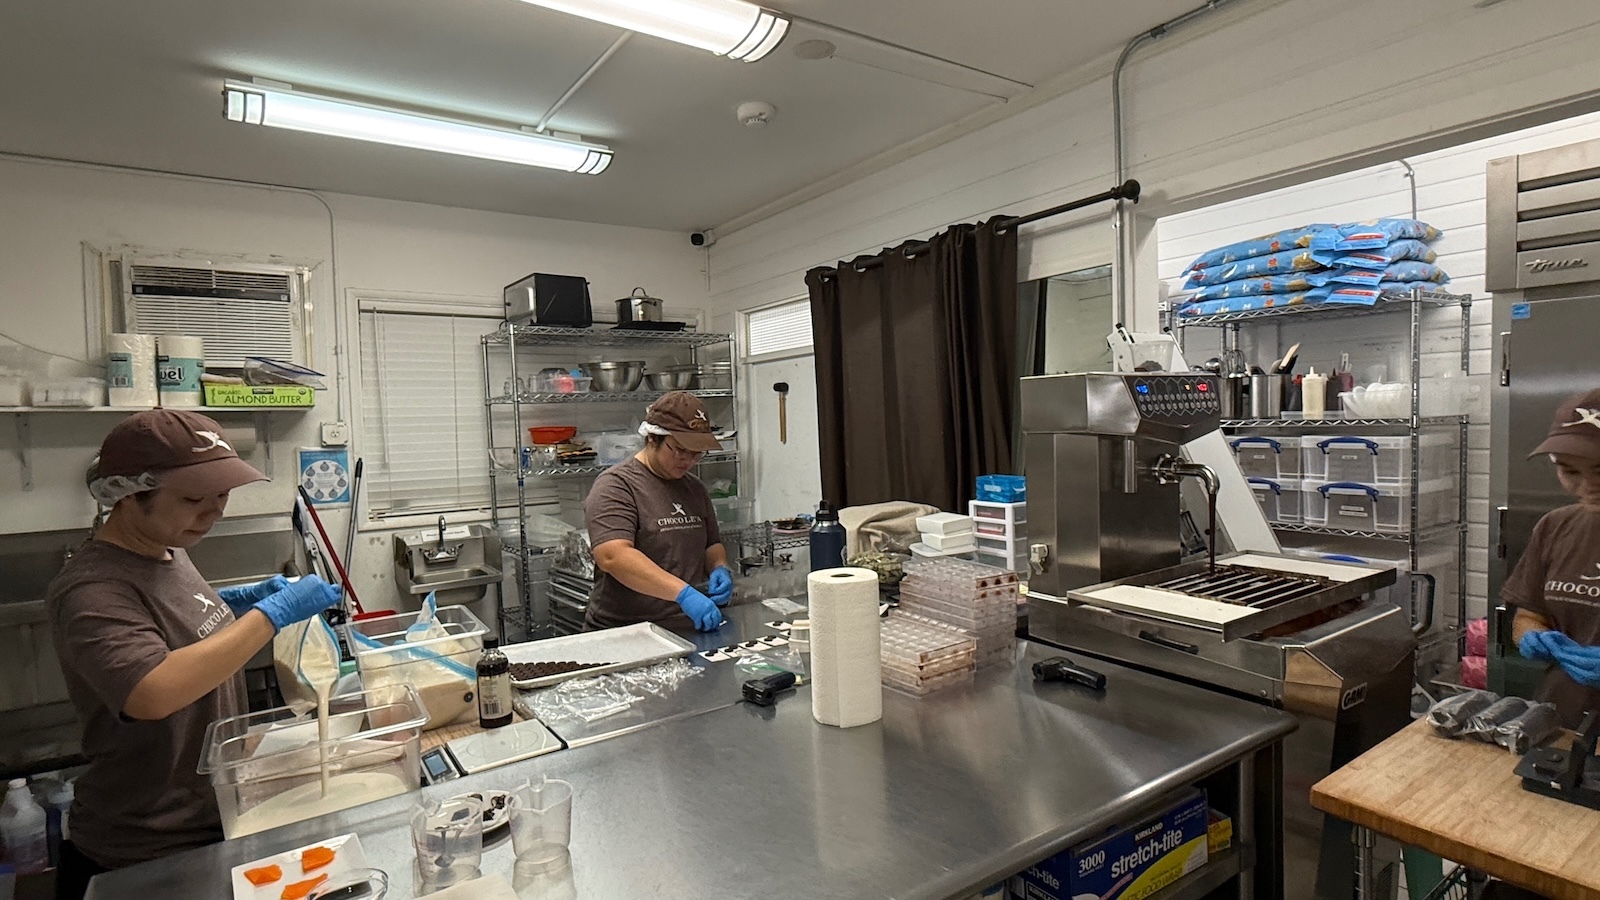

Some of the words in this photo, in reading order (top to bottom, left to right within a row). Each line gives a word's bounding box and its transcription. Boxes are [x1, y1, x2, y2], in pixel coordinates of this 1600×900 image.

[224, 395, 267, 404] ALMOND
[269, 395, 302, 404] BUTTER
[658, 516, 684, 526] CHOCO
[197, 612, 221, 639] CHOCO
[1134, 822, 1164, 841] KIRKLAND
[1078, 850, 1106, 873] 3000
[1111, 829, 1183, 878] stretch-tite
